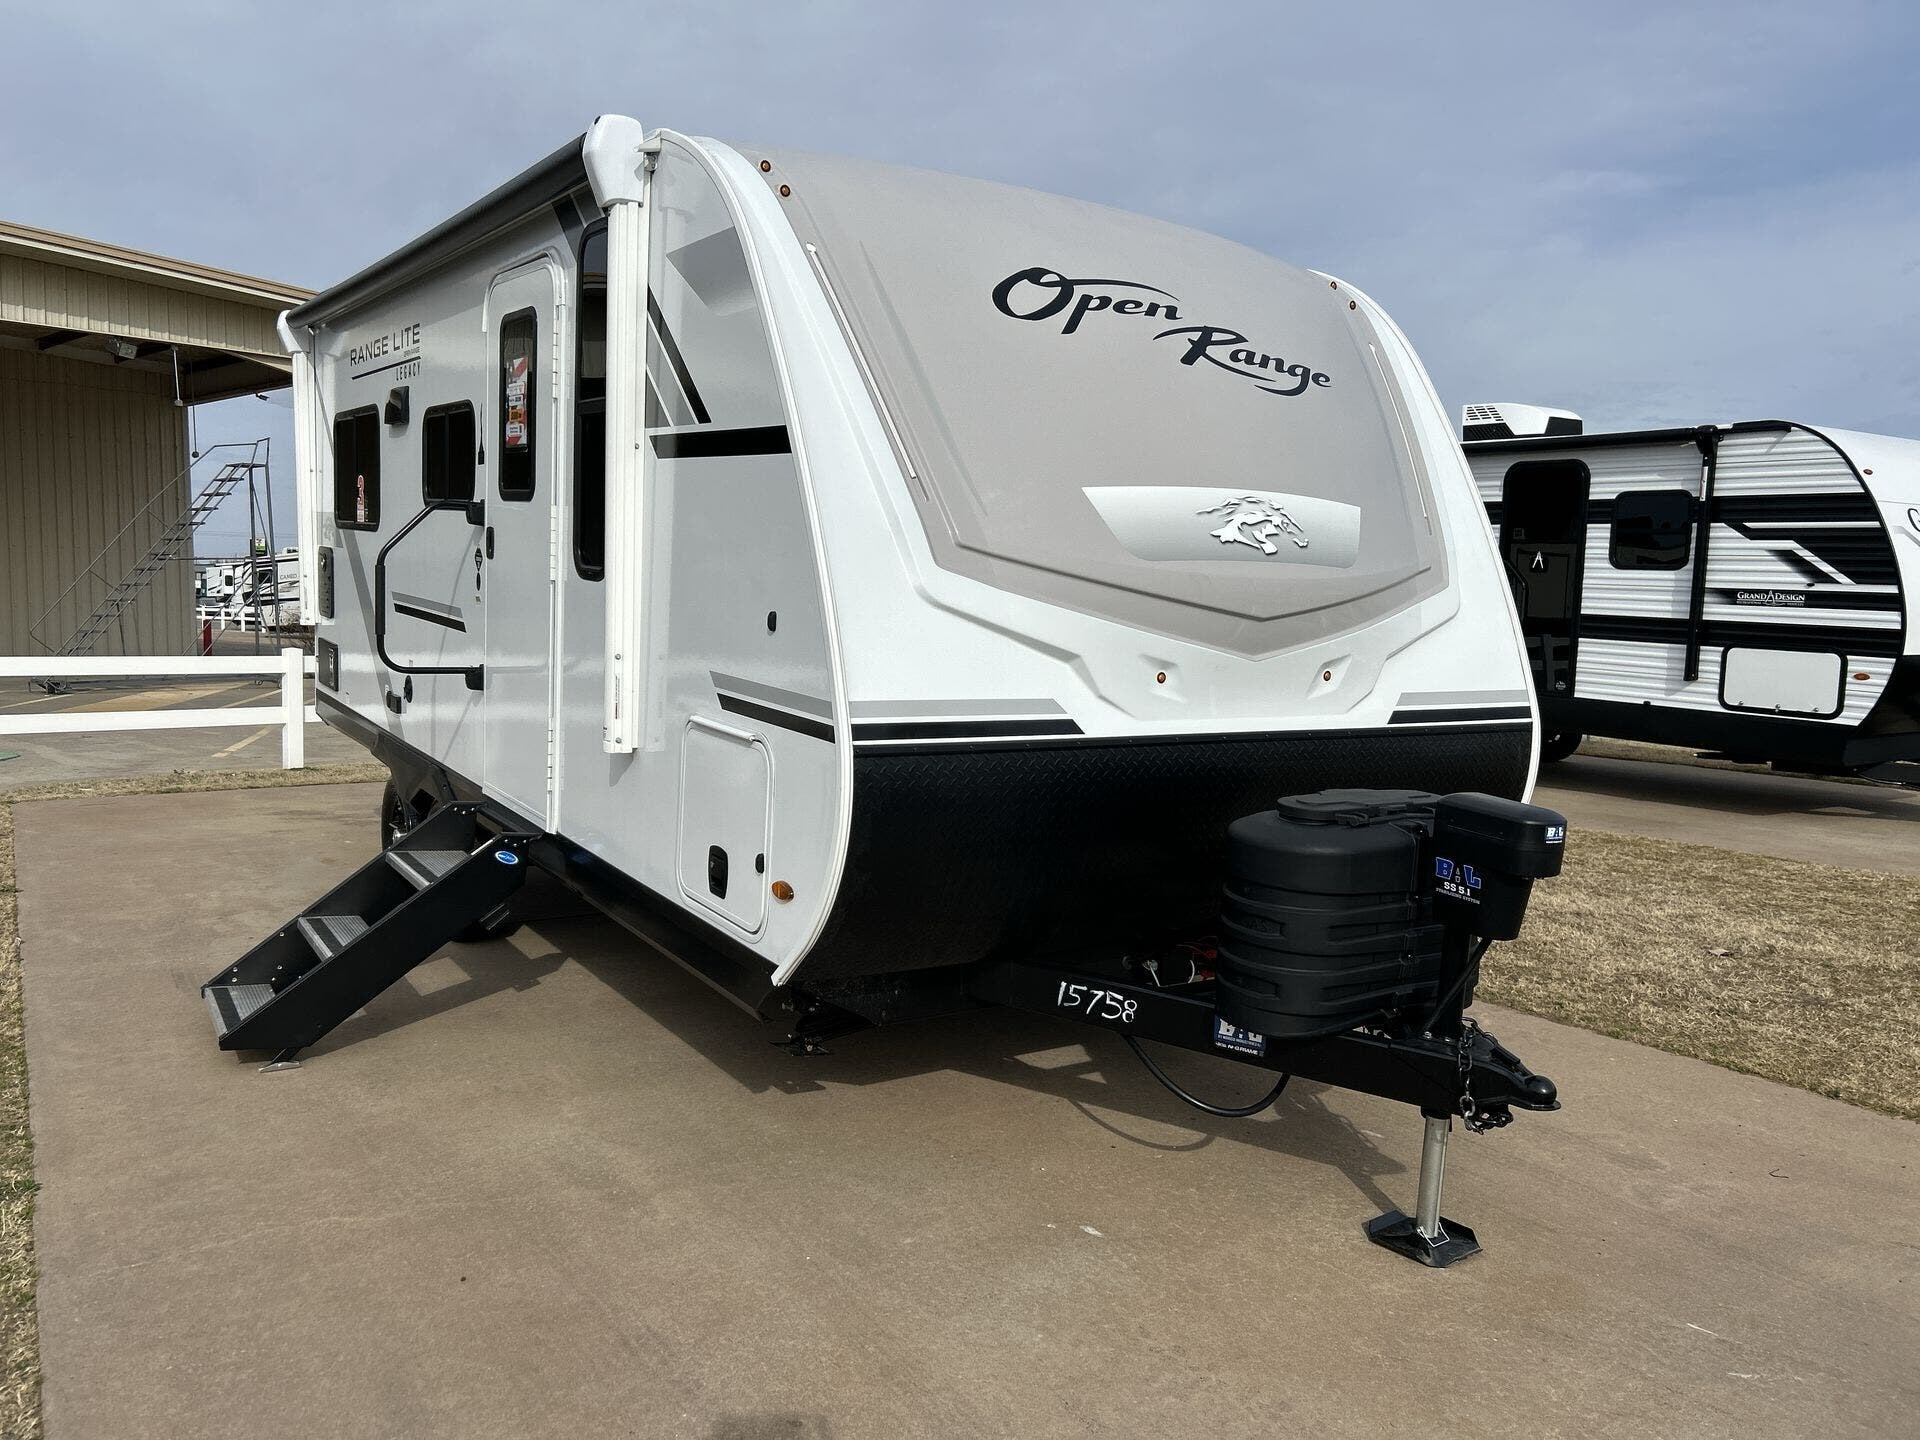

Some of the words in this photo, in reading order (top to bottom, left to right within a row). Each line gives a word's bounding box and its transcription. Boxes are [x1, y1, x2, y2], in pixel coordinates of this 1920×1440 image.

[992, 267, 1183, 335] Open
[350, 335, 389, 367] RANGE
[393, 322, 421, 352] LITE
[1153, 325, 1332, 397] Range
[396, 361, 421, 381] LEGACY
[1737, 591, 1767, 600] GRAND
[1774, 592, 1806, 601] DESIGN
[1444, 881, 1457, 892] SS
[1458, 886, 1471, 897] 5.1
[1057, 980, 1138, 1023] 15758
